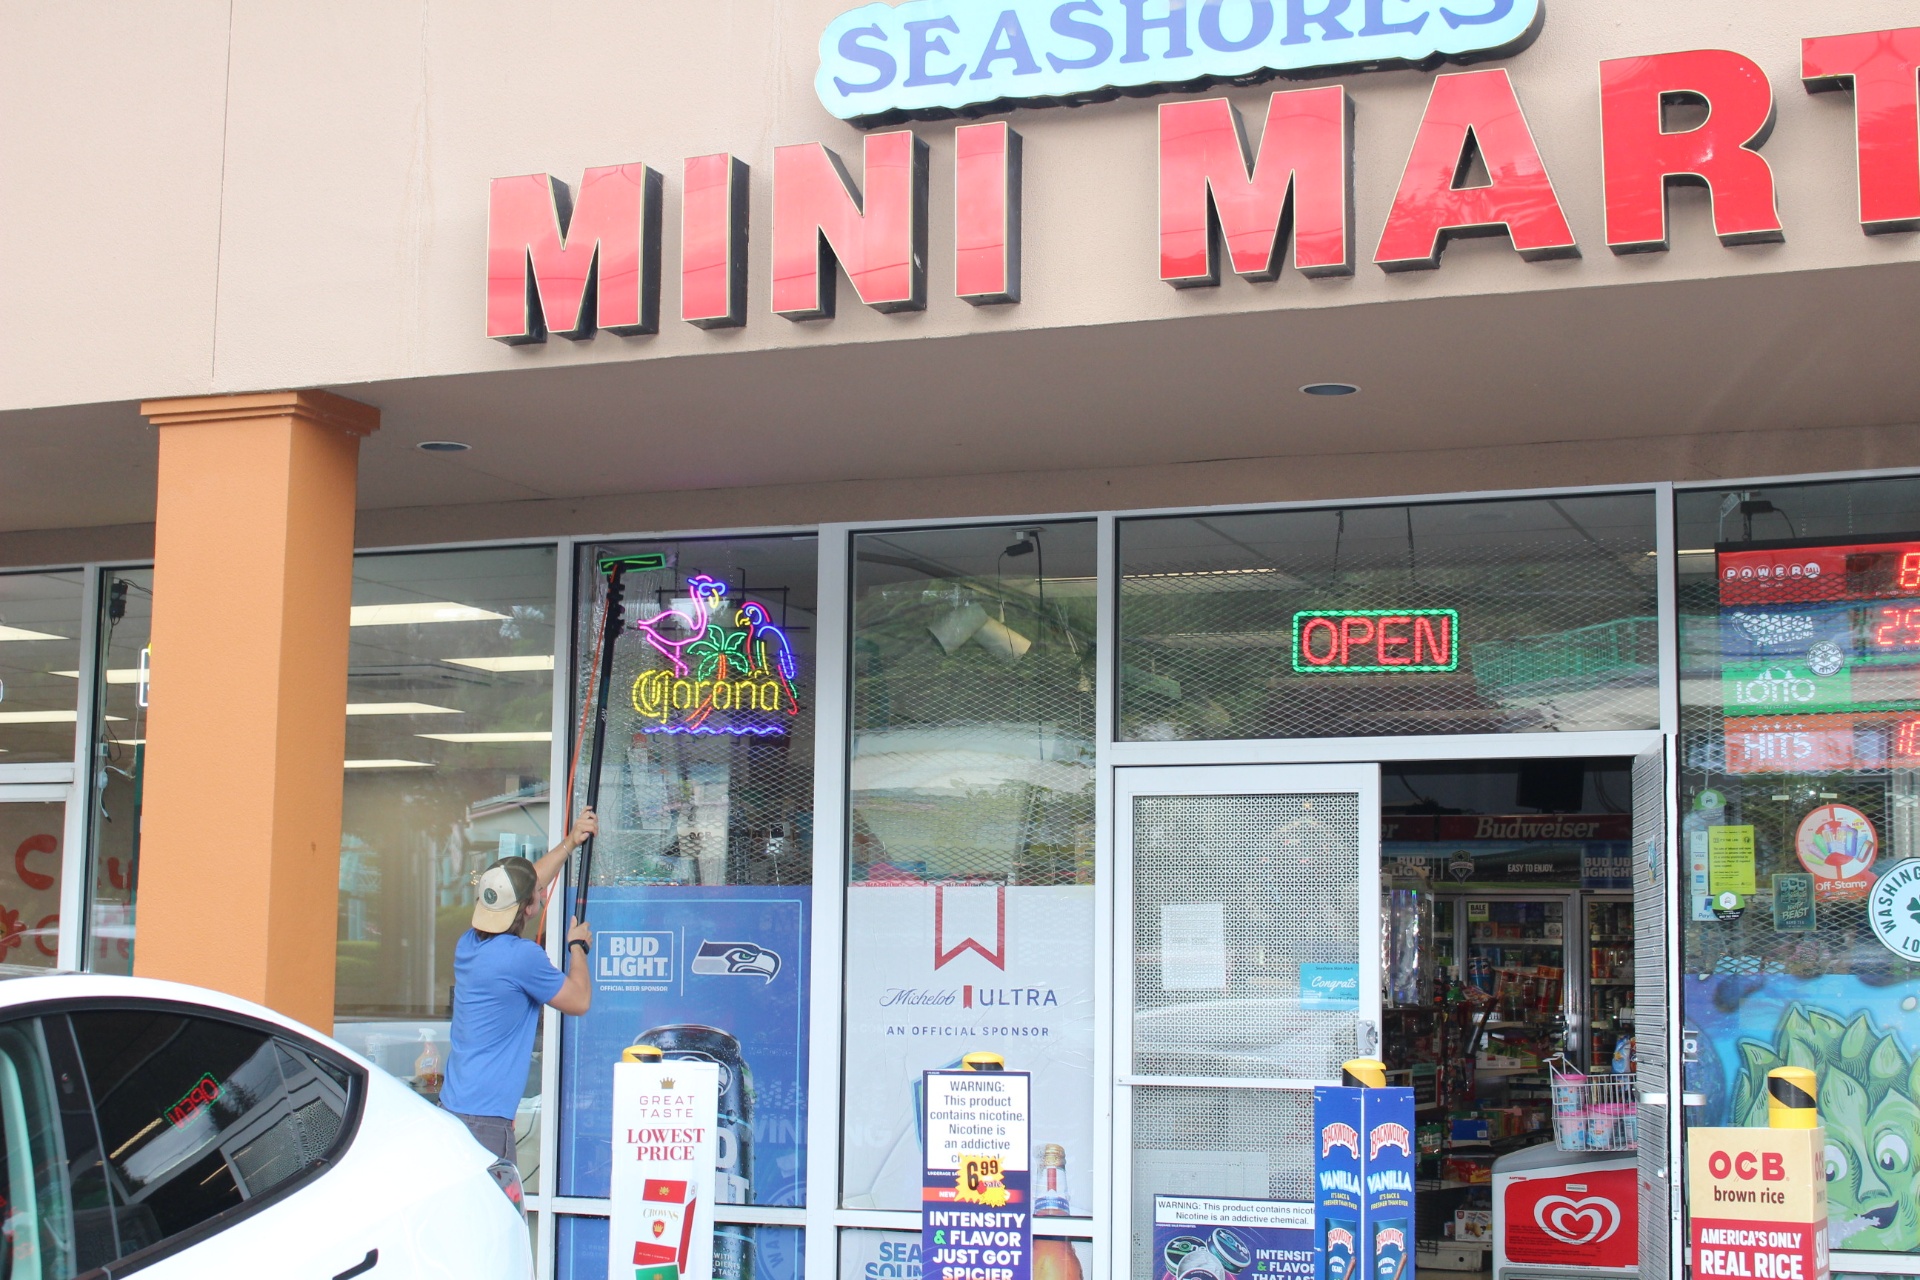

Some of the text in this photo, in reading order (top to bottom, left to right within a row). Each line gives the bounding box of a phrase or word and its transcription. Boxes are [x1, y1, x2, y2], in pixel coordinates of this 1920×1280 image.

[486, 26, 1920, 340] MINI MART
[1302, 617, 1450, 665] OPEN
[632, 669, 779, 724] Corona
[1736, 677, 1816, 705] LOTTO
[1475, 816, 1600, 838] Budweiser
[1508, 864, 1523, 872] EASY
[1525, 864, 1533, 872] TO
[1613, 857, 1631, 867] UD
[1816, 881, 1867, 891] Off-Stamp
[611, 937, 659, 956] BUD
[600, 957, 669, 976] LIGHT
[1311, 976, 1357, 991] Congrats
[879, 988, 1058, 1007] Michelob ULTRA
[886, 1026, 1049, 1037] AN OFFICIAL SPONSOR
[950, 1081, 1005, 1093] WARNING:
[639, 1095, 695, 1106] GREAT
[944, 1095, 1011, 1108] This product
[640, 1108, 694, 1118] TASTE
[929, 1111, 1025, 1122] contains nicotine.
[627, 1128, 706, 1144] LOWEST
[949, 1124, 1006, 1135] Nicotine is
[944, 1139, 1010, 1150] an addictive
[1322, 1123, 1360, 1160] BACKWOODS
[1370, 1122, 1410, 1161] BACKWOODS
[636, 1146, 695, 1161] PRICE
[1709, 1150, 1786, 1182] OCB
[1320, 1170, 1361, 1196] VANILLA
[1367, 1170, 1412, 1195] VANILLA
[1714, 1185, 1785, 1205] brown rice
[642, 1207, 679, 1222] CROWNS
[1158, 1201, 1201, 1210] WARNING:
[1203, 1203, 1221, 1211] This
[1222, 1203, 1254, 1213] product
[1256, 1205, 1291, 1214] contains
[929, 1211, 1025, 1229] INTENSITY
[1176, 1212, 1209, 1221] Nicotine
[1211, 1213, 1218, 1221] is
[1232, 1214, 1268, 1223] addictive
[1270, 1215, 1309, 1225] chemical.
[933, 1230, 1022, 1247] & FLAVOR
[1700, 1228, 1768, 1248] AMERICA'S
[1768, 1232, 1802, 1250] ONLY
[932, 1249, 1022, 1266] JUST GOT
[1256, 1249, 1314, 1261] INTENSIT
[1257, 1261, 1266, 1271] &
[1700, 1250, 1803, 1280] REAL RICE
[942, 1267, 1014, 1280] SPICIER
